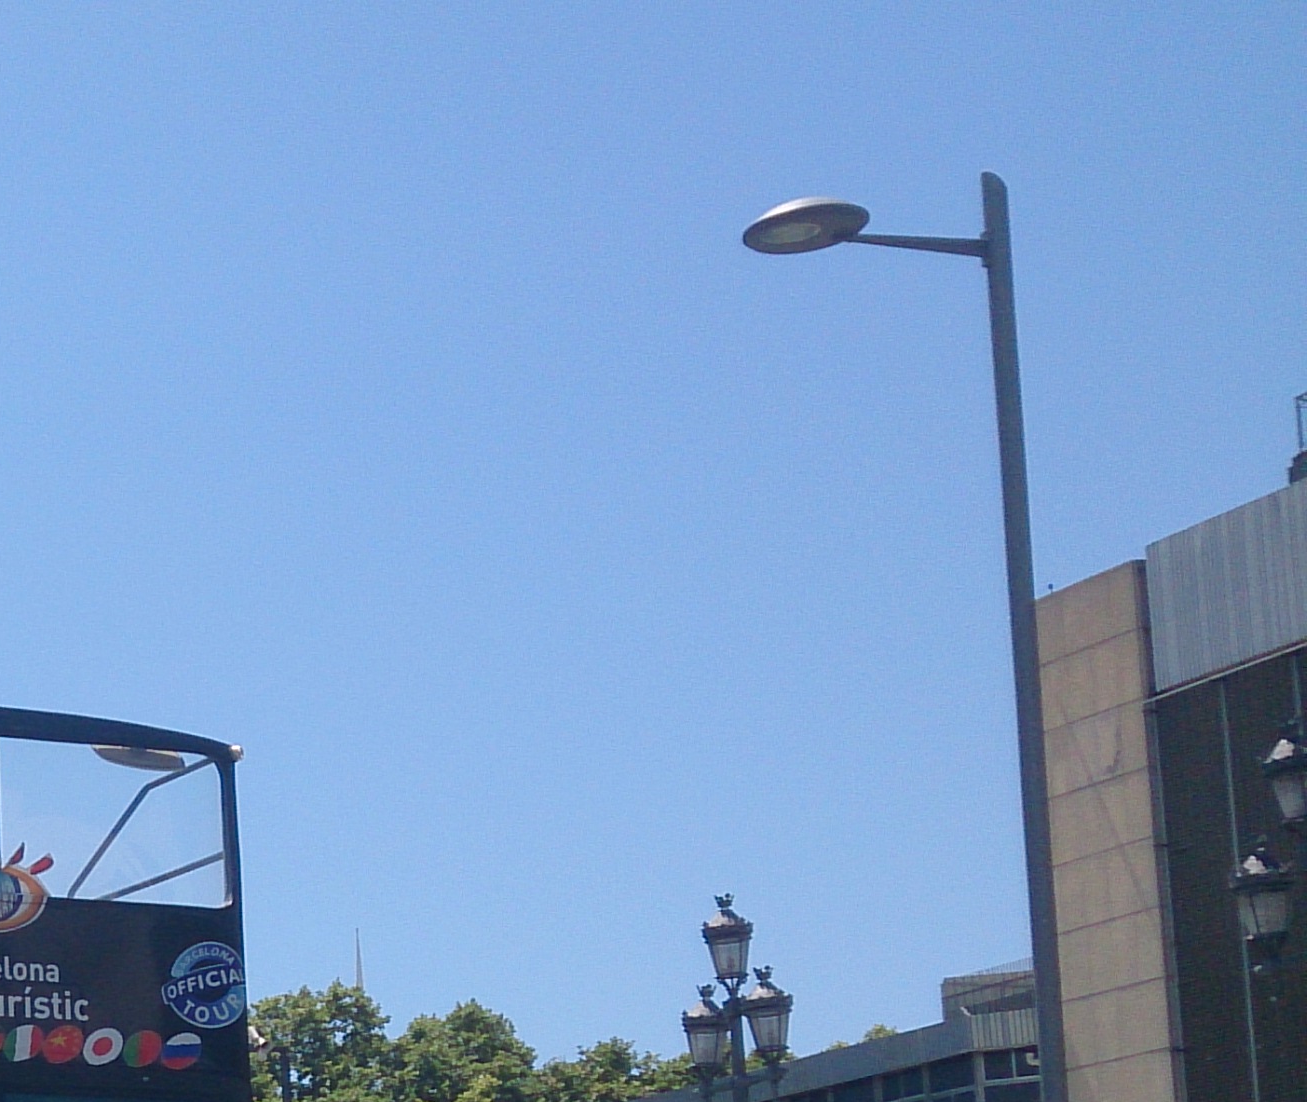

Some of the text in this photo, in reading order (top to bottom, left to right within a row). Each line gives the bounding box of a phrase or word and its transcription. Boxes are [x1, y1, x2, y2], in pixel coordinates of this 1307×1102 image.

[172, 947, 235, 978] BARCELONA
[167, 968, 245, 999] OFFICIAL
[183, 993, 240, 1023] TOUR
